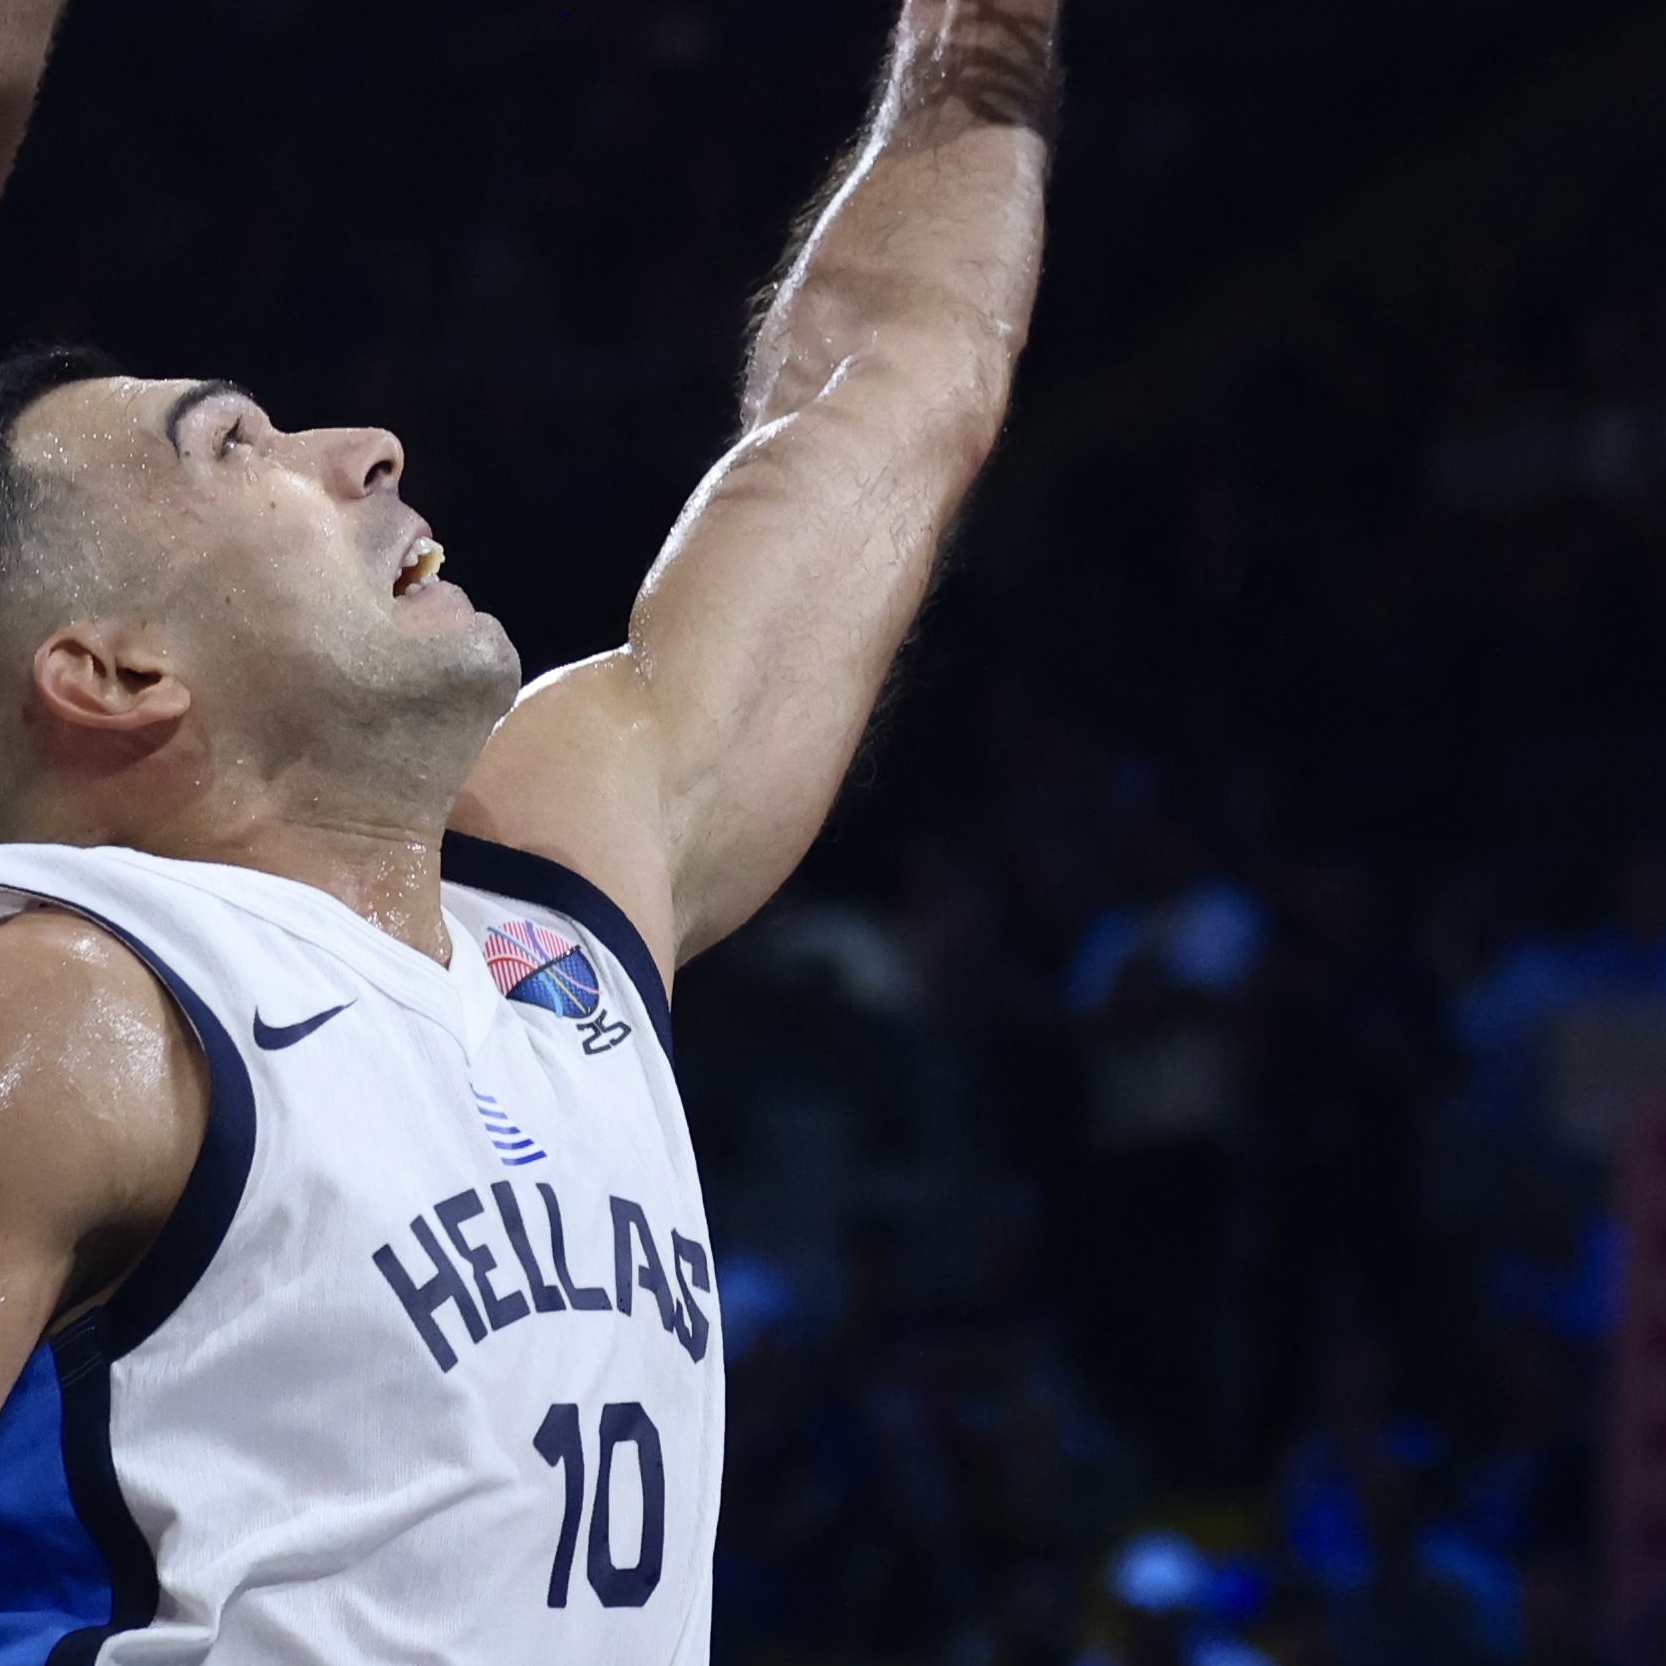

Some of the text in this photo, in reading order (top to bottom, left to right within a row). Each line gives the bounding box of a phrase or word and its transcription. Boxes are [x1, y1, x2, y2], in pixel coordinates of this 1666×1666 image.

[576, 1009, 632, 1055] 25
[372, 1180, 711, 1374] HELLAS
[532, 1401, 665, 1609] 10
